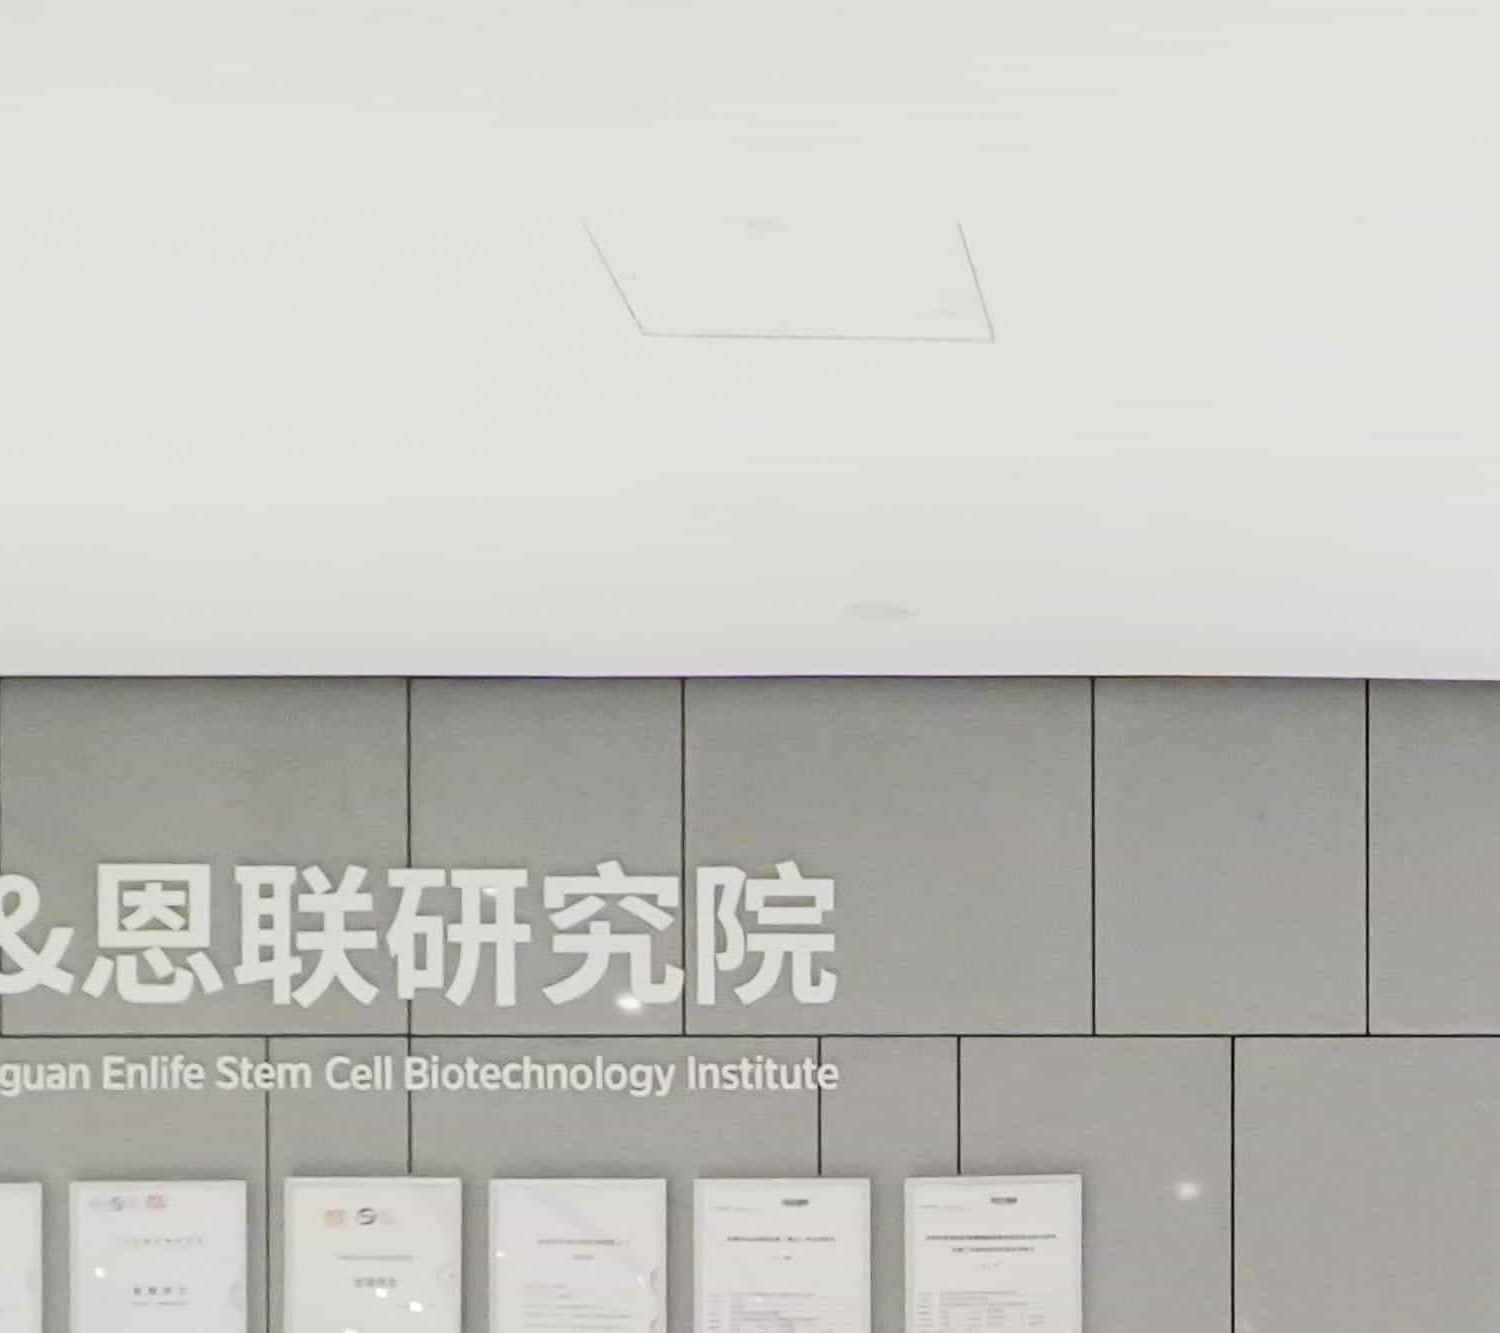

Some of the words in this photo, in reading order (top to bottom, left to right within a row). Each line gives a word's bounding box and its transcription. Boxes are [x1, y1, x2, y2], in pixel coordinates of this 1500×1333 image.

[102, 1055, 205, 1091] Enlife
[216, 1055, 312, 1091] Stem
[325, 1055, 393, 1091] Cell
[404, 1055, 676, 1098] Biotechnology
[687, 1055, 839, 1091] Institute
